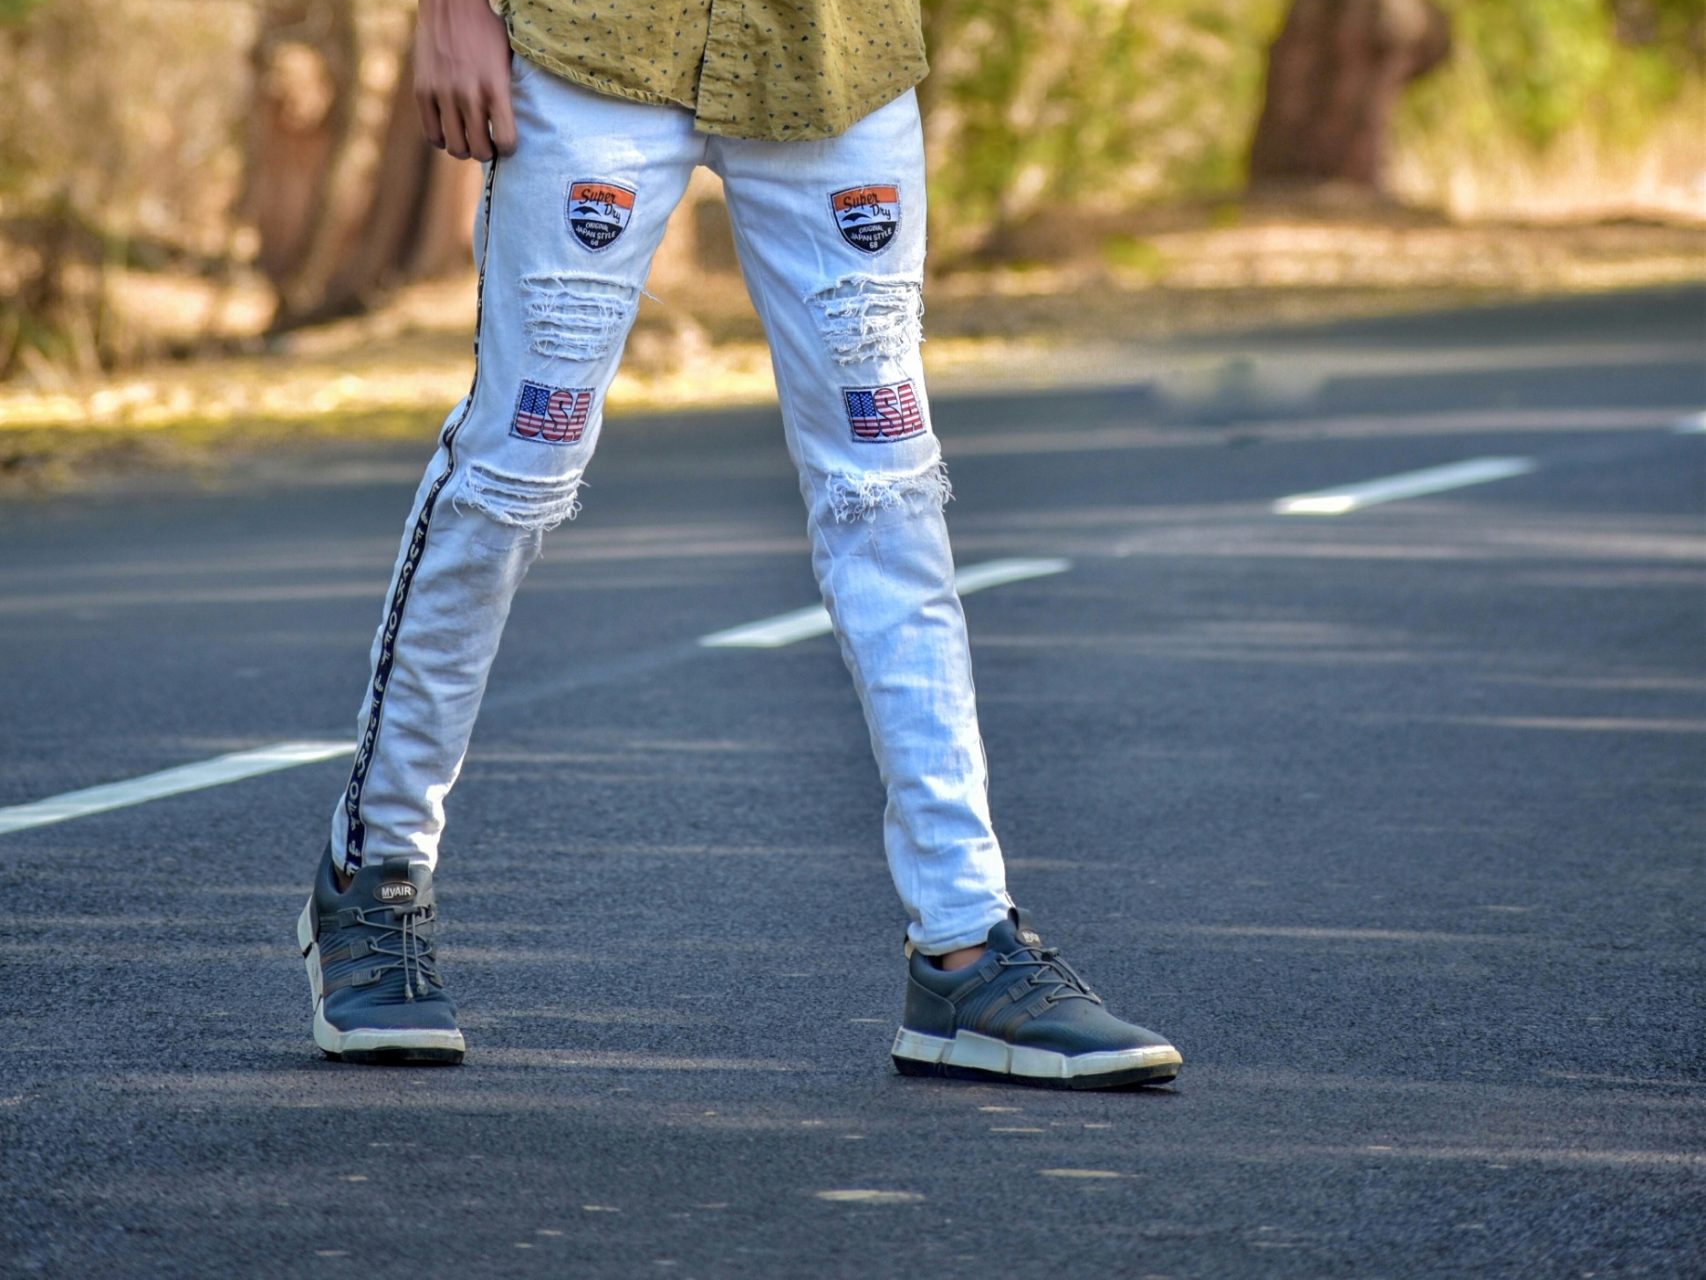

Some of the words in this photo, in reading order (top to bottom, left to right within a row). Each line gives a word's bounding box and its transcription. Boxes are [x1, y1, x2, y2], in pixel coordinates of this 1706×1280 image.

[579, 188, 617, 206] Super
[843, 193, 880, 213] Super
[604, 204, 621, 224] Dry
[870, 203, 892, 220] Dry
[575, 224, 596, 238] JAPAN
[597, 231, 617, 240] STYLE
[873, 227, 893, 241] STYLE
[515, 384, 591, 442] USA
[845, 383, 923, 438] USA
